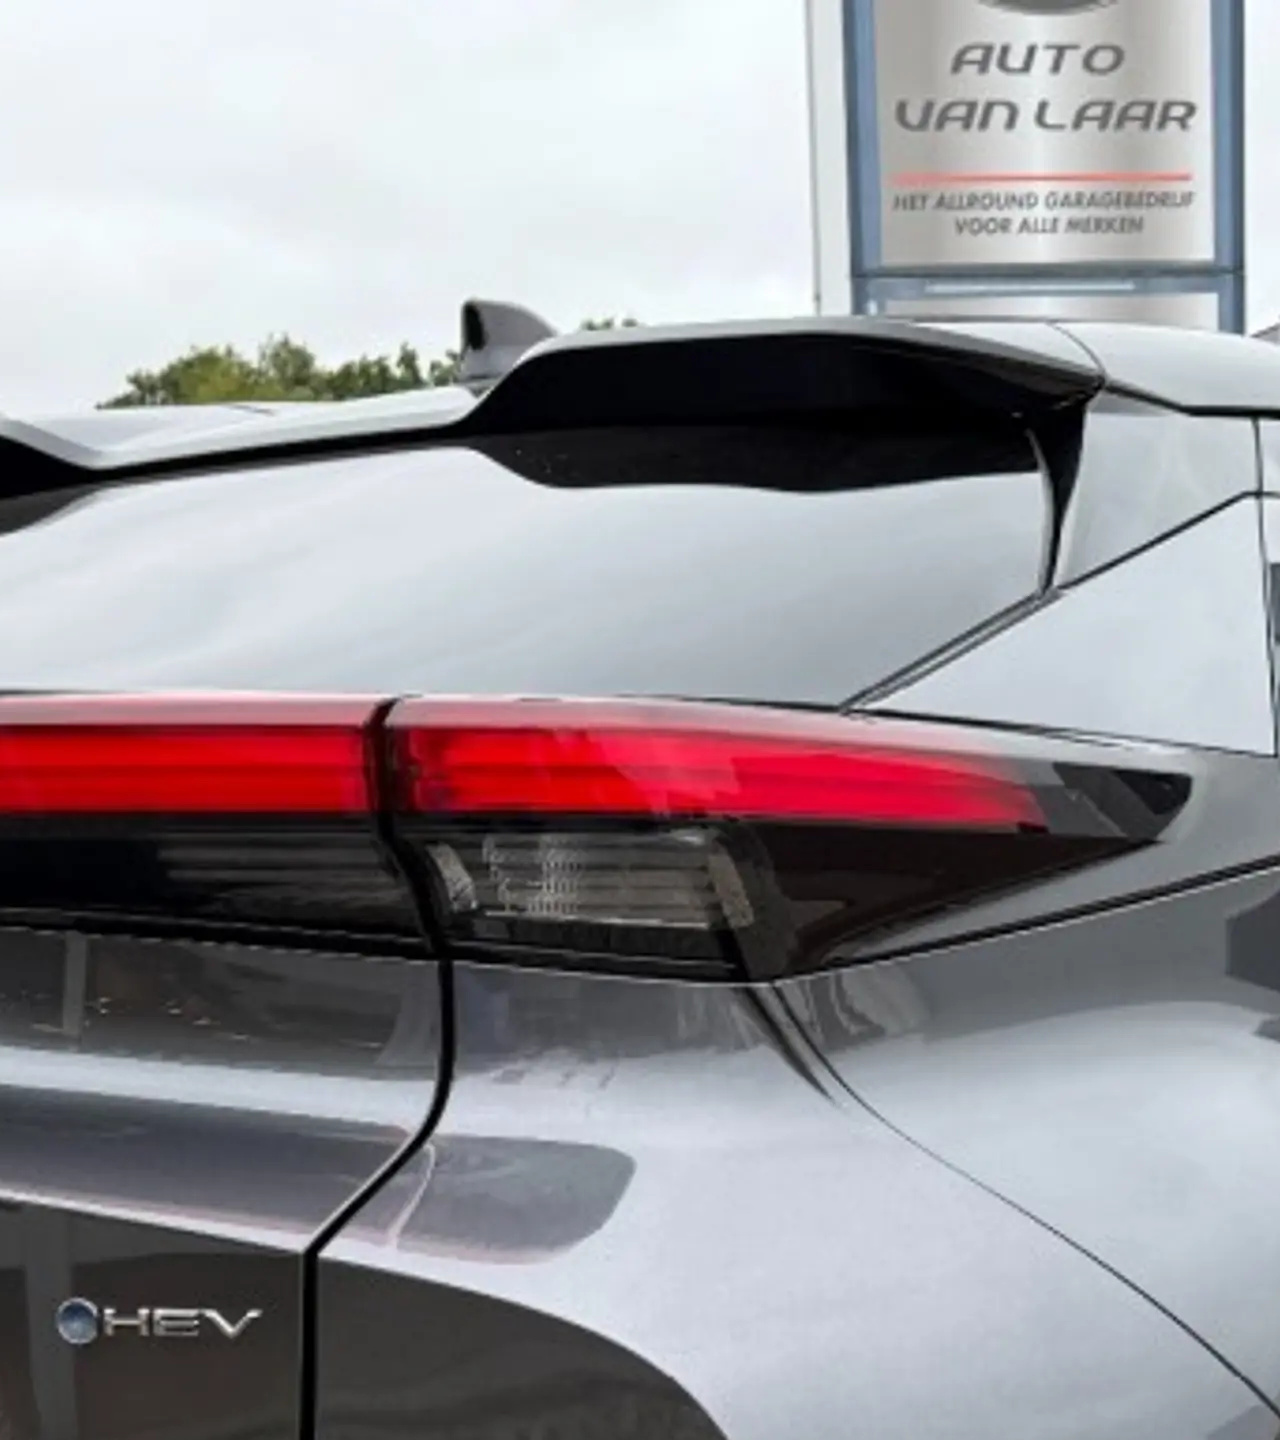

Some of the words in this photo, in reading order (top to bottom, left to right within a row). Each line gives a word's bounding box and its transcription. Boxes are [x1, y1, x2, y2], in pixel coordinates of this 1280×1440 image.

[949, 42, 1126, 76] AUTO
[894, 99, 1019, 132] VAN
[1033, 99, 1197, 132] LAAR
[892, 194, 928, 212] HET
[933, 192, 1039, 211] ALLROUND
[1044, 190, 1195, 209] GARAGEBEDRIJF
[955, 217, 1013, 236] VOOR
[1017, 216, 1060, 235] ALLE
[1064, 215, 1144, 234] MERKEN
[103, 1306, 264, 1339] HEV
